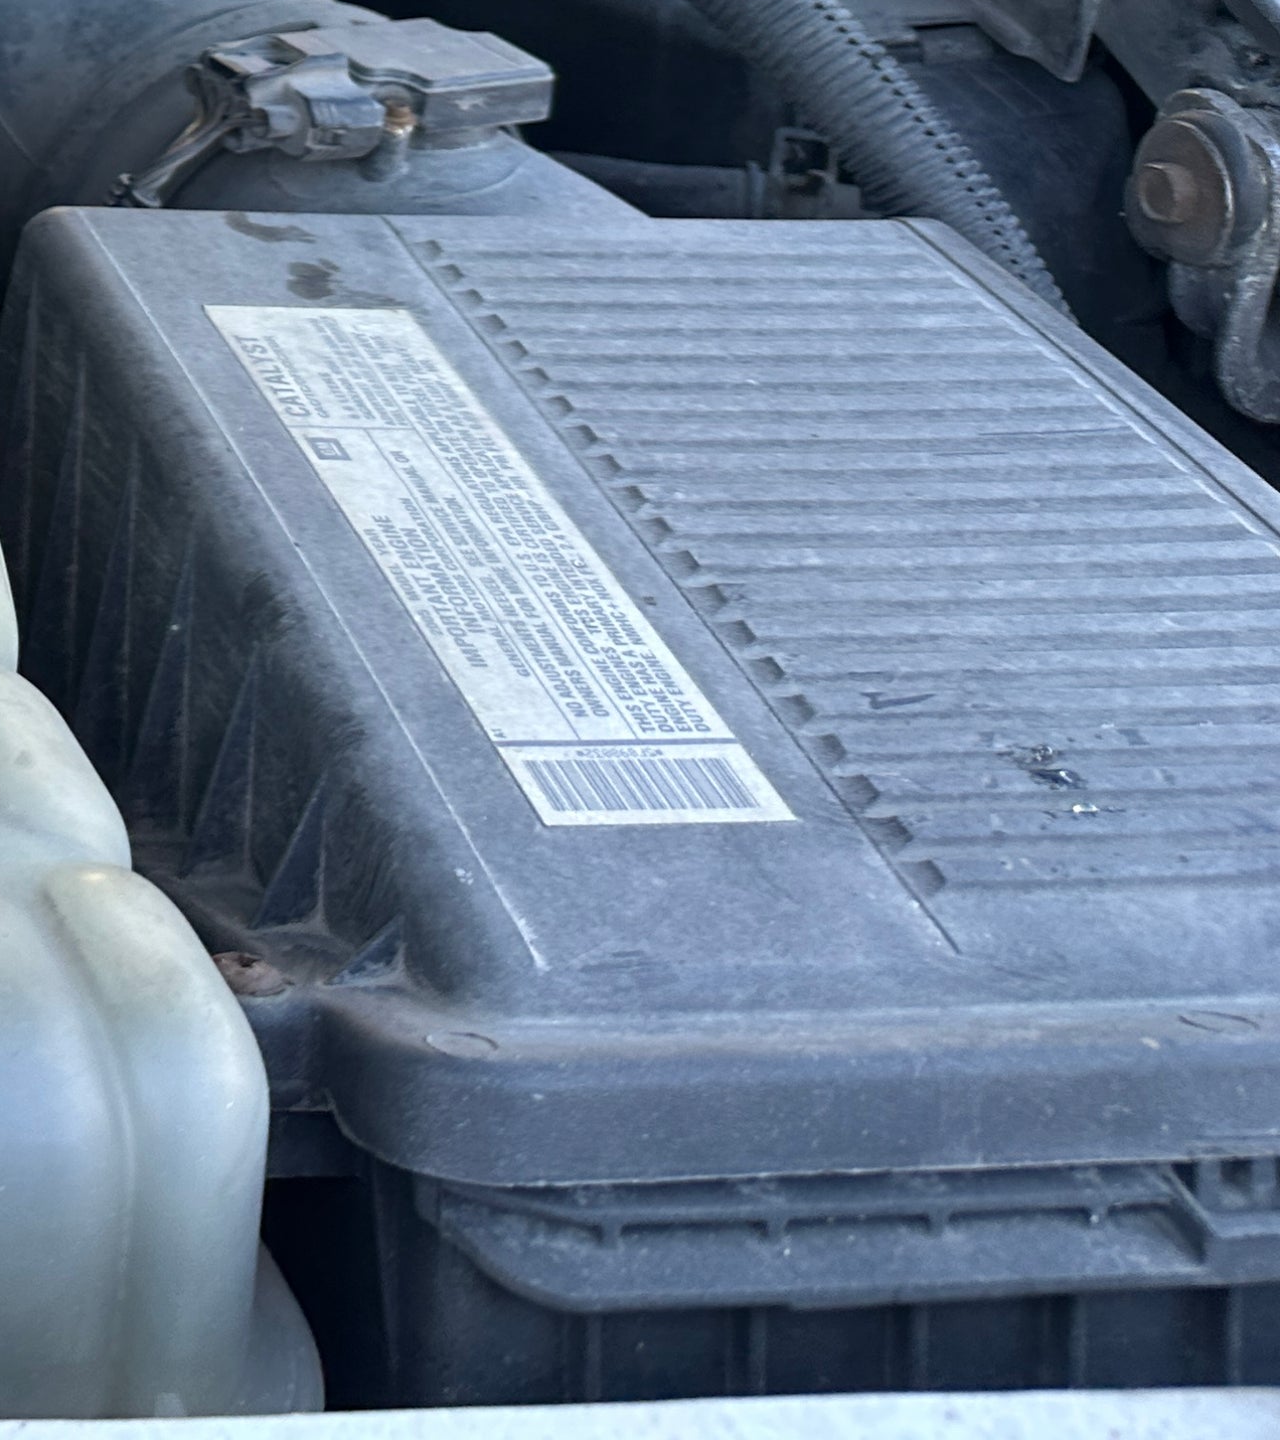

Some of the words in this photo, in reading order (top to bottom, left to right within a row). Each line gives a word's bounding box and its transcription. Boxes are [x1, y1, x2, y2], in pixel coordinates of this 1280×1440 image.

[231, 334, 312, 417] CATALYST
[370, 515, 423, 568] ENGINE
[397, 497, 460, 570] CORPORATION
[398, 527, 487, 632] INFORMATION
[450, 574, 495, 621] MOTORS
[409, 574, 489, 667] IMPORTANT
[541, 591, 603, 654] CONFORMS
[577, 593, 630, 645] PRIMARY
[485, 625, 533, 676] GENERAL
[506, 619, 579, 698] ADJUSTMENTS
[528, 622, 576, 666] MANUAL
[562, 669, 611, 716] OWNERS
[589, 658, 635, 700] ENGINE
[627, 661, 659, 684] HAS
[622, 704, 659, 733] THIS
[637, 699, 676, 732] DUTY
[646, 687, 694, 732] ENGINE
[673, 699, 713, 732] DUTY
